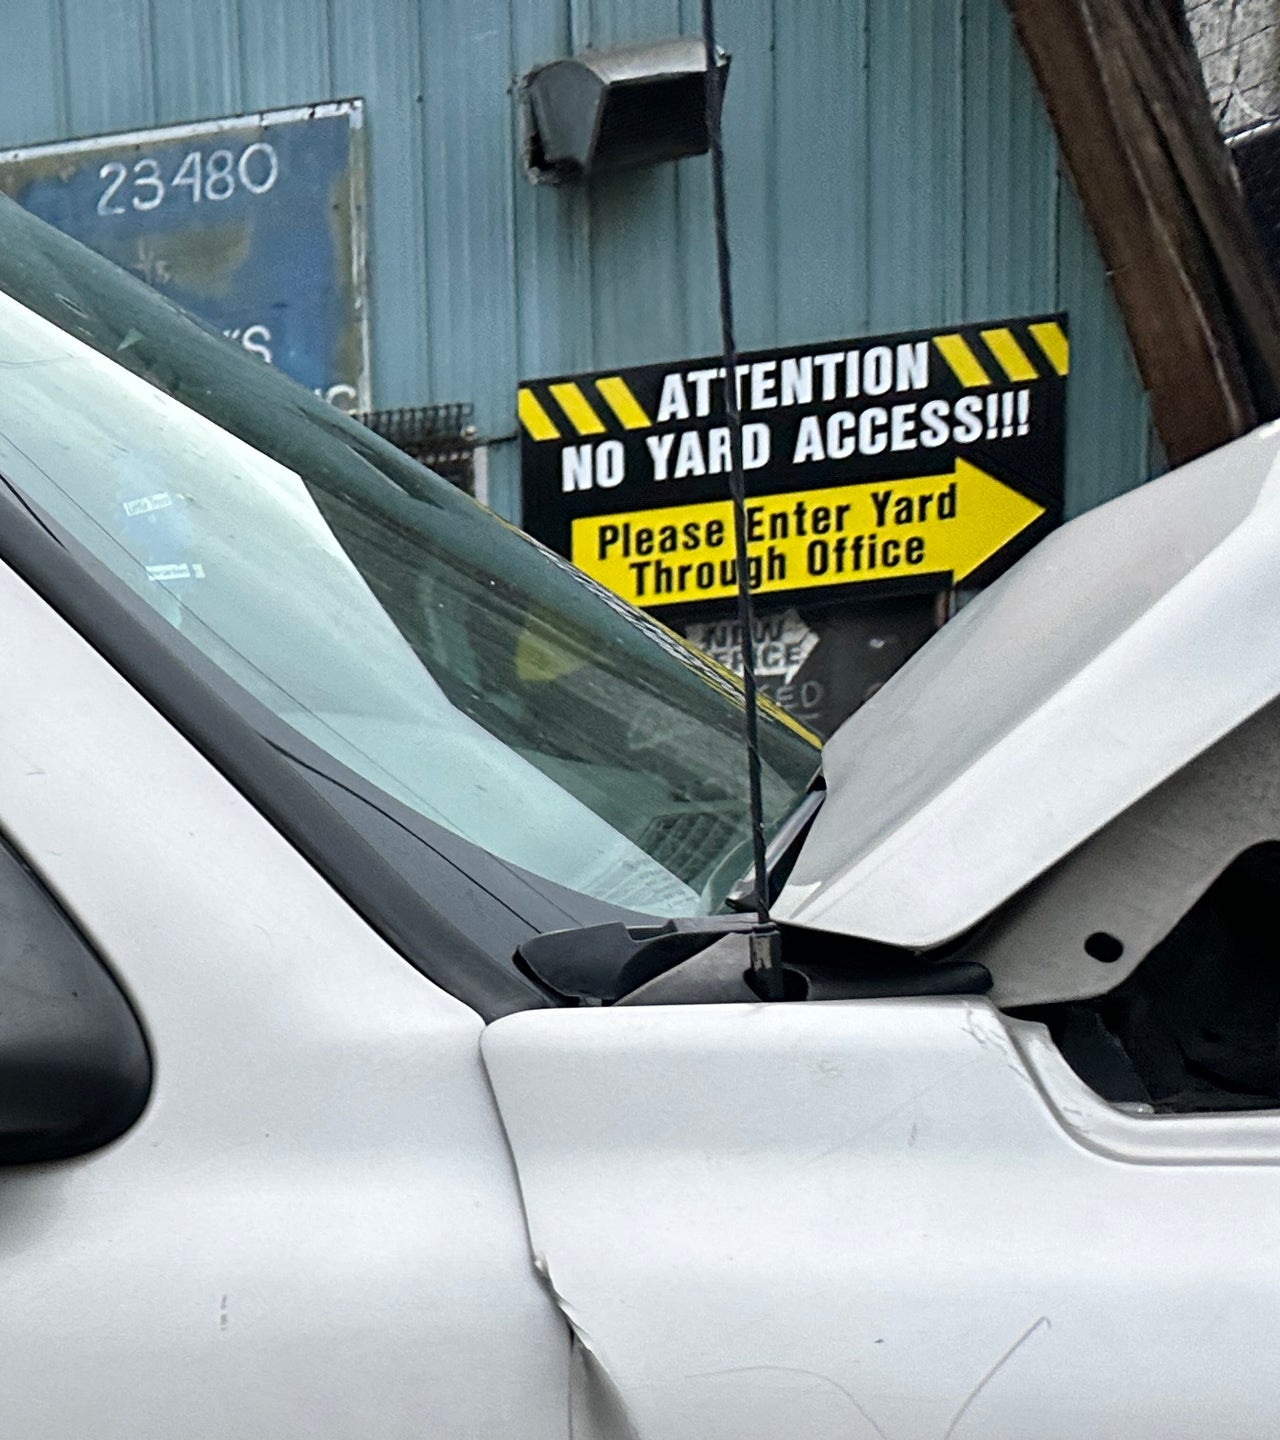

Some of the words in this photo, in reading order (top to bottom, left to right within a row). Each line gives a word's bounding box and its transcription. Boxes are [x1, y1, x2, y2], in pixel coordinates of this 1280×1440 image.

[96, 141, 279, 217] 23480
[656, 340, 929, 423] ATTENTION
[561, 439, 626, 493] NO
[645, 422, 771, 482] YARD
[792, 388, 1031, 464] ACCESS!!!
[598, 518, 725, 561] Please
[746, 501, 851, 543] Enter
[870, 482, 957, 528] Yard
[629, 546, 787, 597] Through
[807, 532, 926, 577] Office
